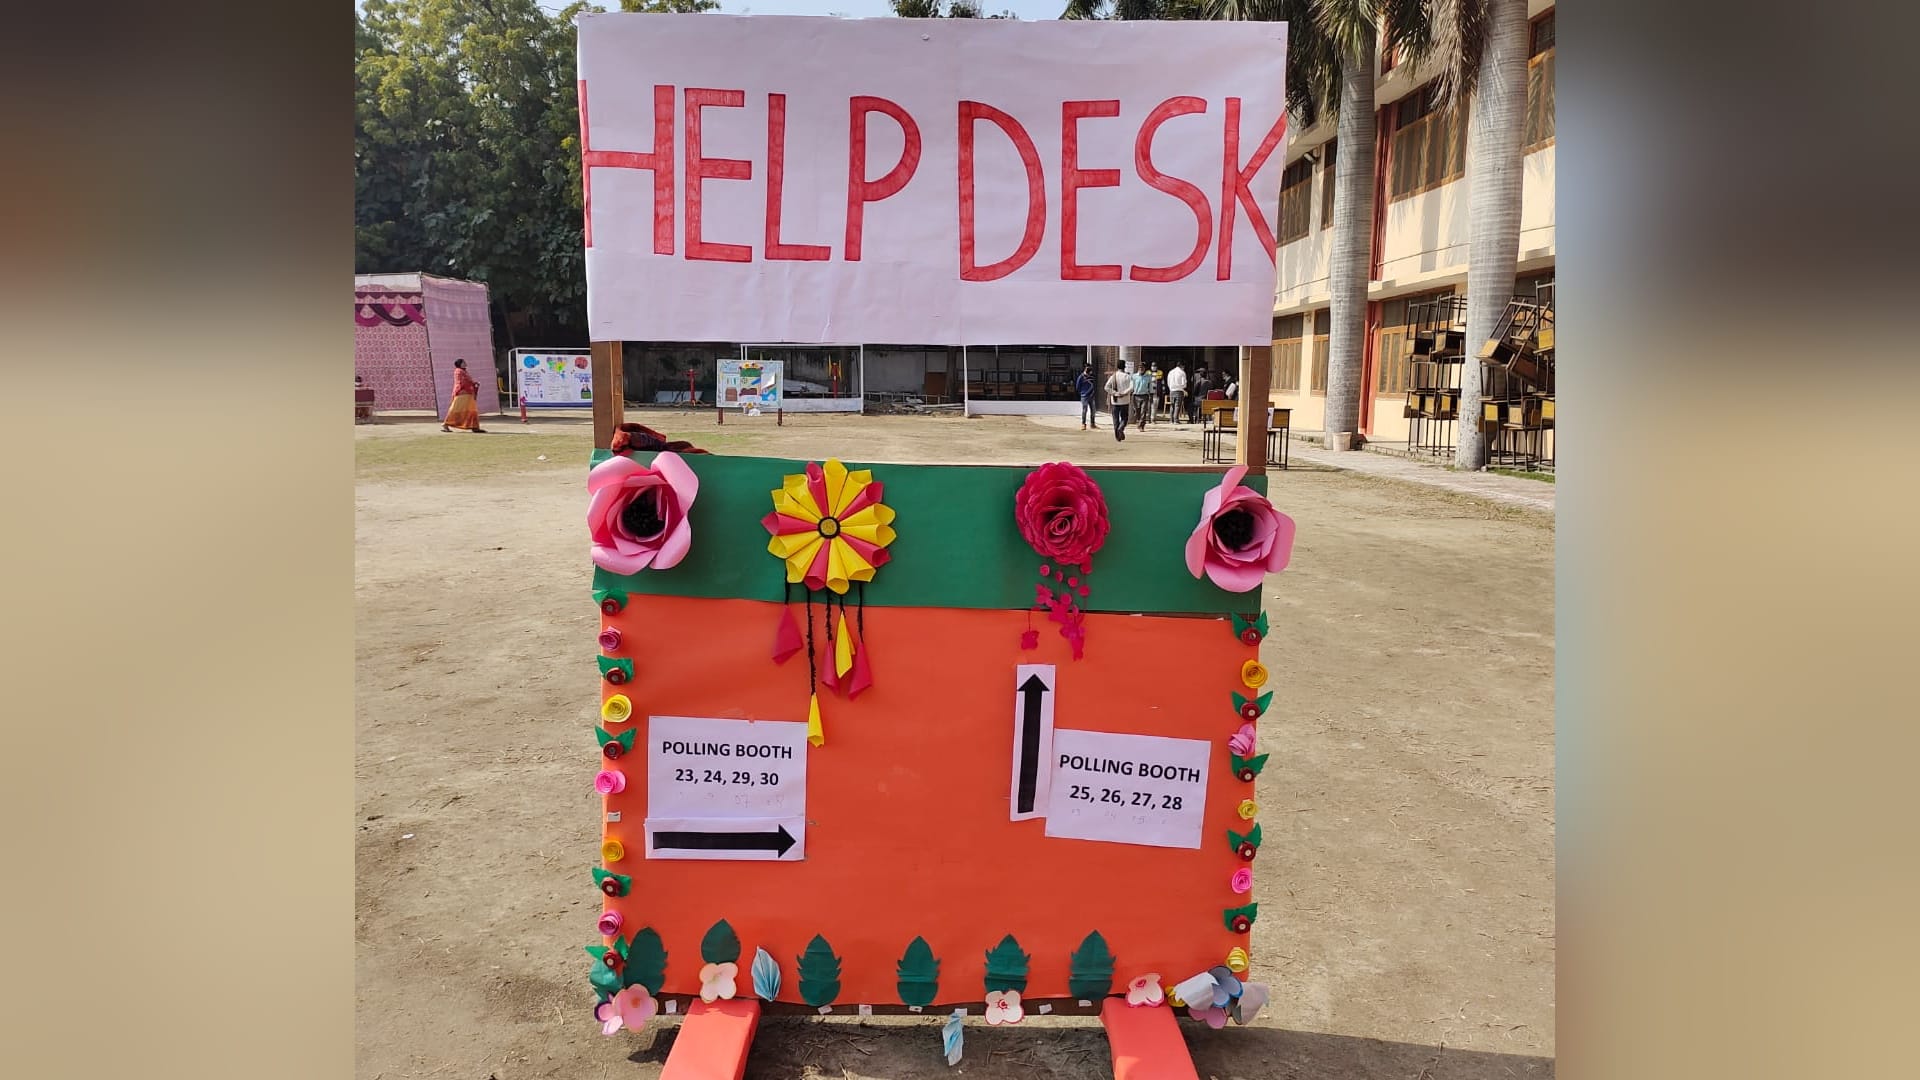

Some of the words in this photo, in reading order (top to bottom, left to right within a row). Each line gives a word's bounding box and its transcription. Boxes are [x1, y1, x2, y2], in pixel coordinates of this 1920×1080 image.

[578, 79, 922, 263] HELP
[957, 96, 1287, 283] DESK
[662, 741, 731, 757] POLLING
[735, 744, 792, 760] BOOTH
[675, 768, 699, 785] 23,
[703, 770, 727, 786] 24,
[732, 771, 755, 787] 29,
[760, 772, 779, 786] 30
[1059, 754, 1134, 776] POLLING
[1138, 763, 1200, 783] BOOTH
[1069, 785, 1095, 803] 25,
[1100, 788, 1125, 807] 26,
[1131, 792, 1156, 810] 27,
[1161, 795, 1183, 810] 28
